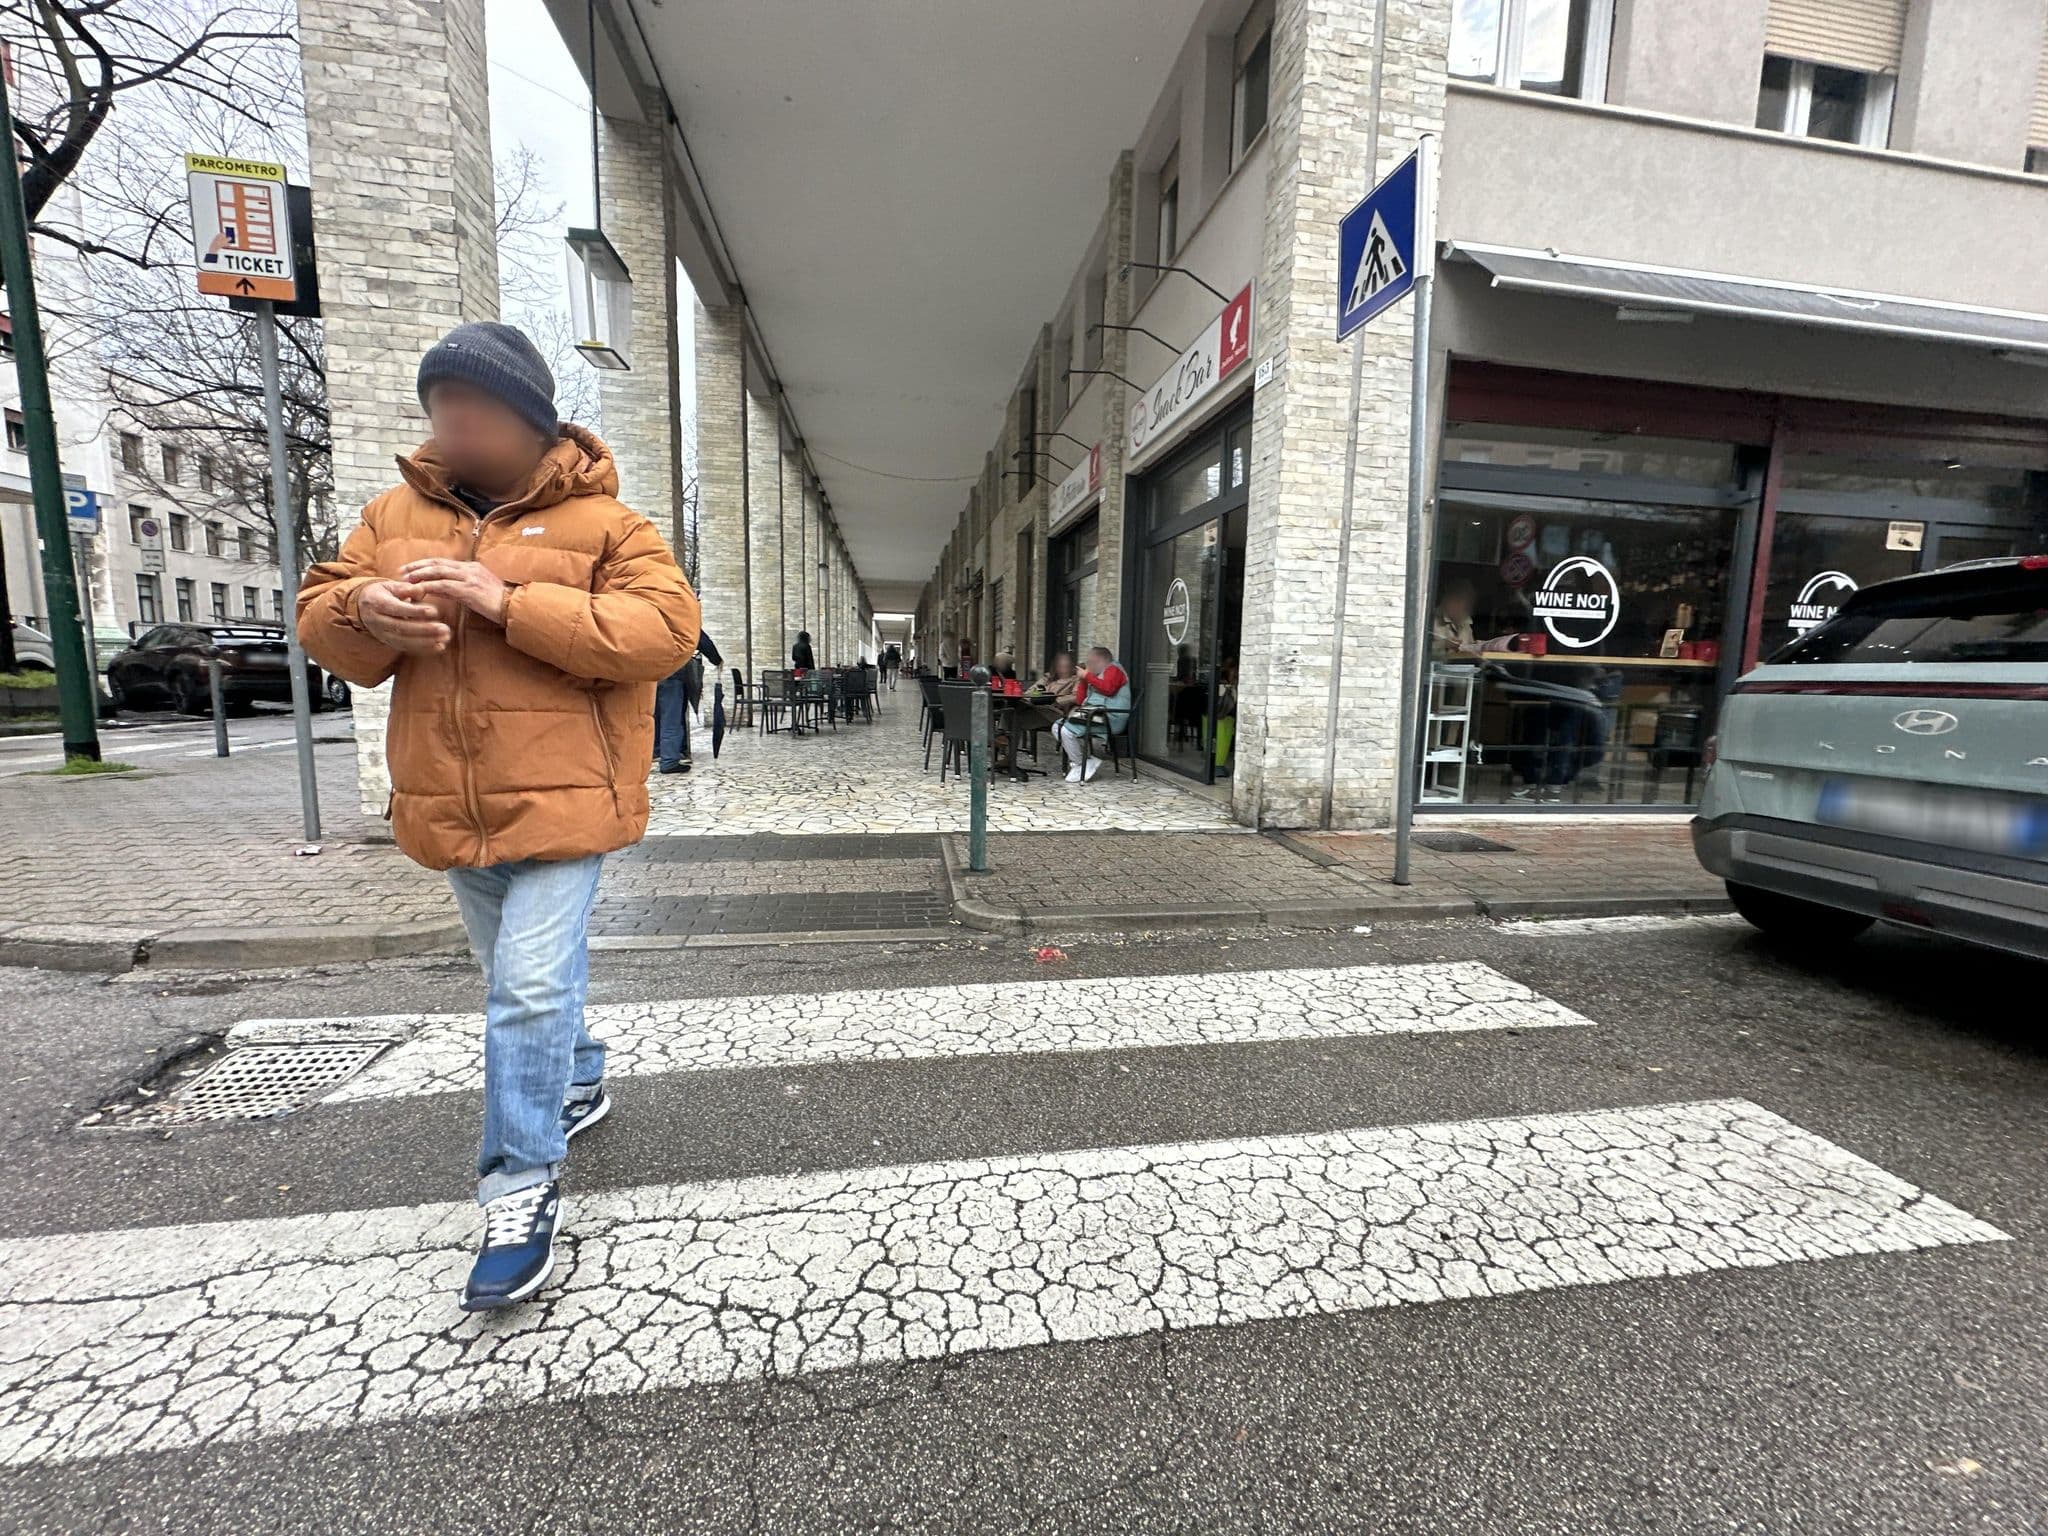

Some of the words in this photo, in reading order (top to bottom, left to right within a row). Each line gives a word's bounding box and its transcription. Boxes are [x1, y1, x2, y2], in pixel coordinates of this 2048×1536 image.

[192, 157, 278, 176] PARCOMETRO
[224, 255, 284, 274] TICKET
[1149, 364, 1186, 430] Snack
[1185, 350, 1212, 400] Bar
[64, 490, 88, 514] P
[1535, 591, 1573, 607] WINE
[1576, 593, 1608, 609] NOT
[1790, 604, 1825, 619] WINE
